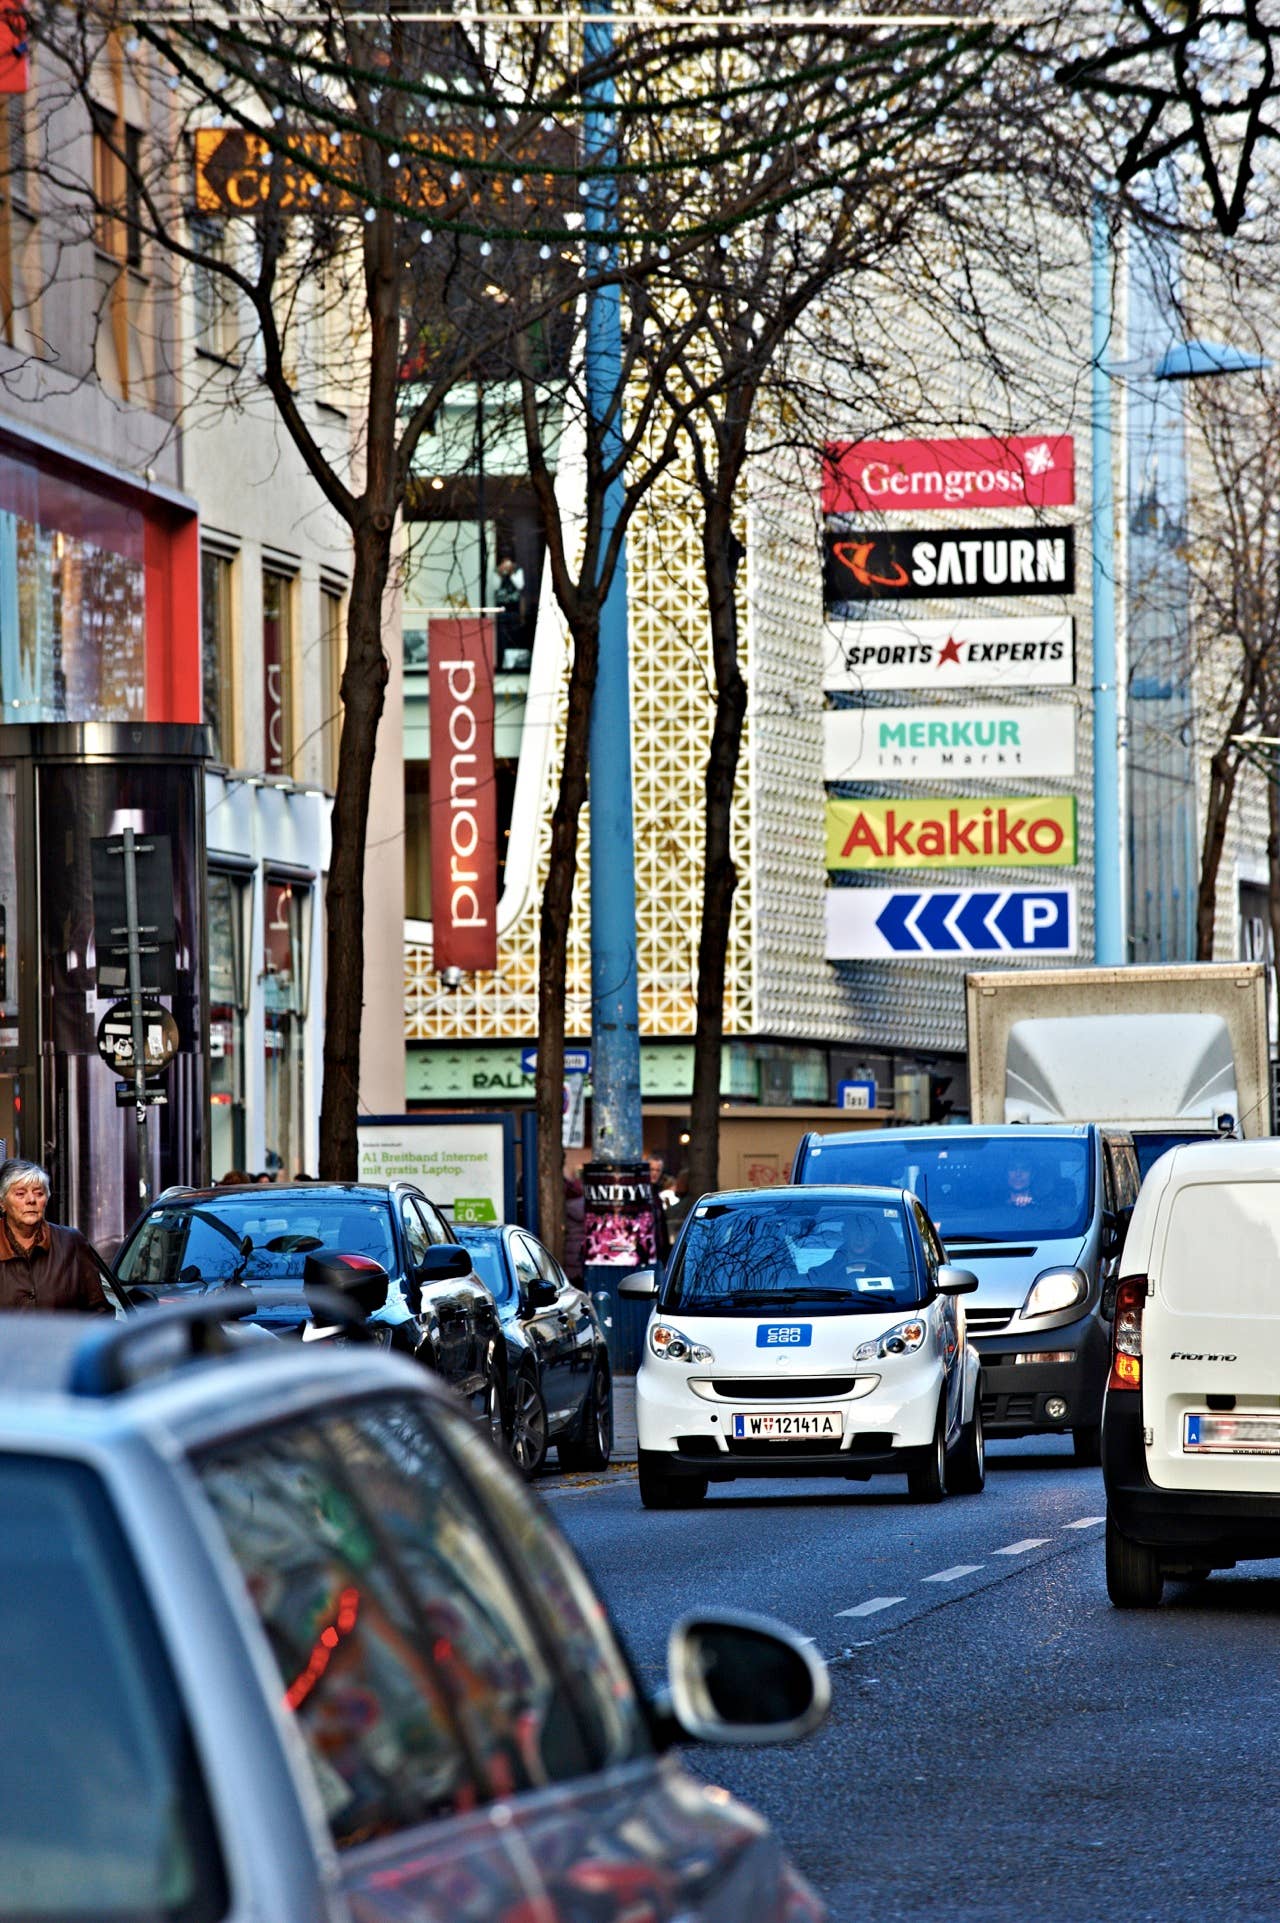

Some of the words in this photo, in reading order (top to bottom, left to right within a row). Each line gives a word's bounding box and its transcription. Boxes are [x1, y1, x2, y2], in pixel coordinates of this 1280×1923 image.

[862, 463, 1025, 502] Gerngross
[912, 538, 1066, 587] SATURN
[847, 645, 932, 665] SPORTS
[967, 641, 1064, 662] EXPERTS
[879, 721, 1020, 748] MERKUR
[879, 753, 917, 766] Ihr
[942, 752, 1021, 765] Markt
[439, 660, 487, 928] promod
[840, 807, 1064, 857] Akakiko
[1022, 898, 1059, 944] P
[362, 1152, 377, 1162] A1
[381, 1151, 438, 1162] Breitband
[442, 1151, 488, 1162] Internet
[362, 1164, 381, 1175] mit
[385, 1163, 418, 1177] gratis
[585, 1185, 637, 1201] ANITY
[766, 1335, 801, 1343] 2GO
[767, 1327, 801, 1336] CAR
[750, 1418, 762, 1434] W
[1190, 1433, 1197, 1441] A
